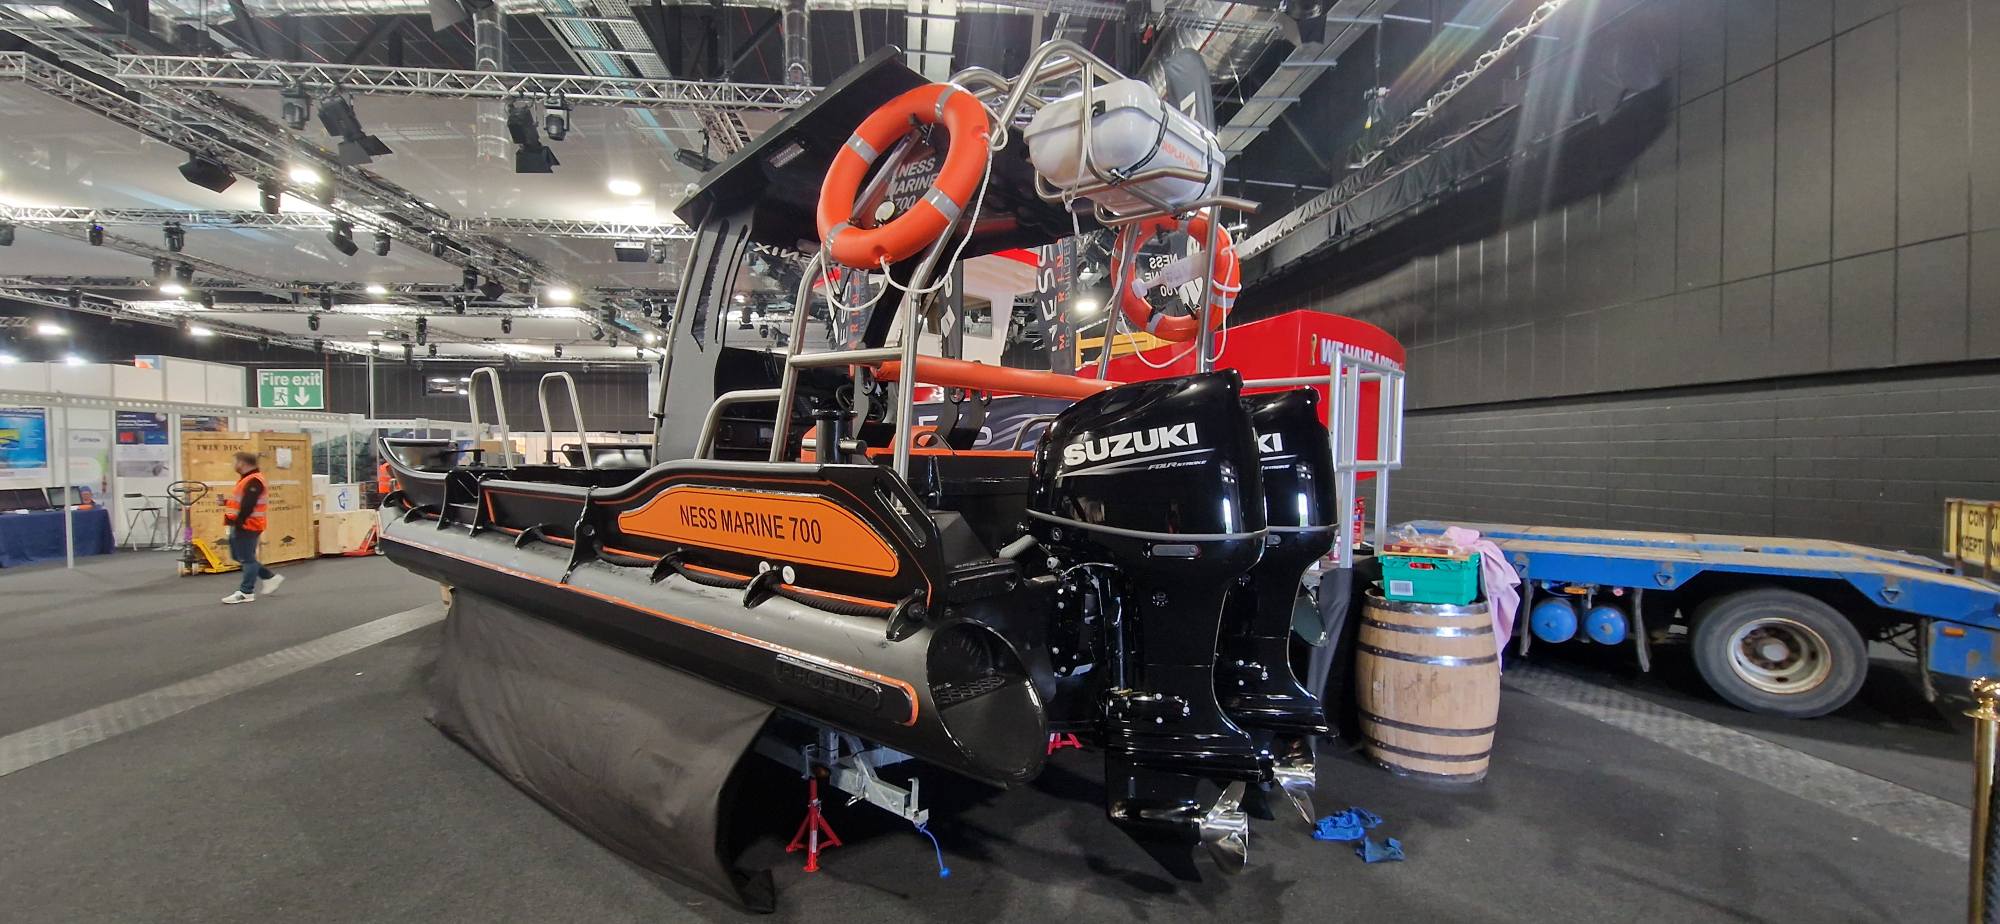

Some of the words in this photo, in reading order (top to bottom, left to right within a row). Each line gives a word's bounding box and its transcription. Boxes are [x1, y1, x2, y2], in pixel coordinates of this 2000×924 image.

[898, 157, 936, 178] NESS
[260, 372, 289, 386] Fire
[292, 372, 321, 386] exit
[1063, 422, 1199, 467] SUZUKI
[680, 504, 718, 530] NESS
[720, 509, 785, 540] MARINE
[788, 516, 822, 545] 700
